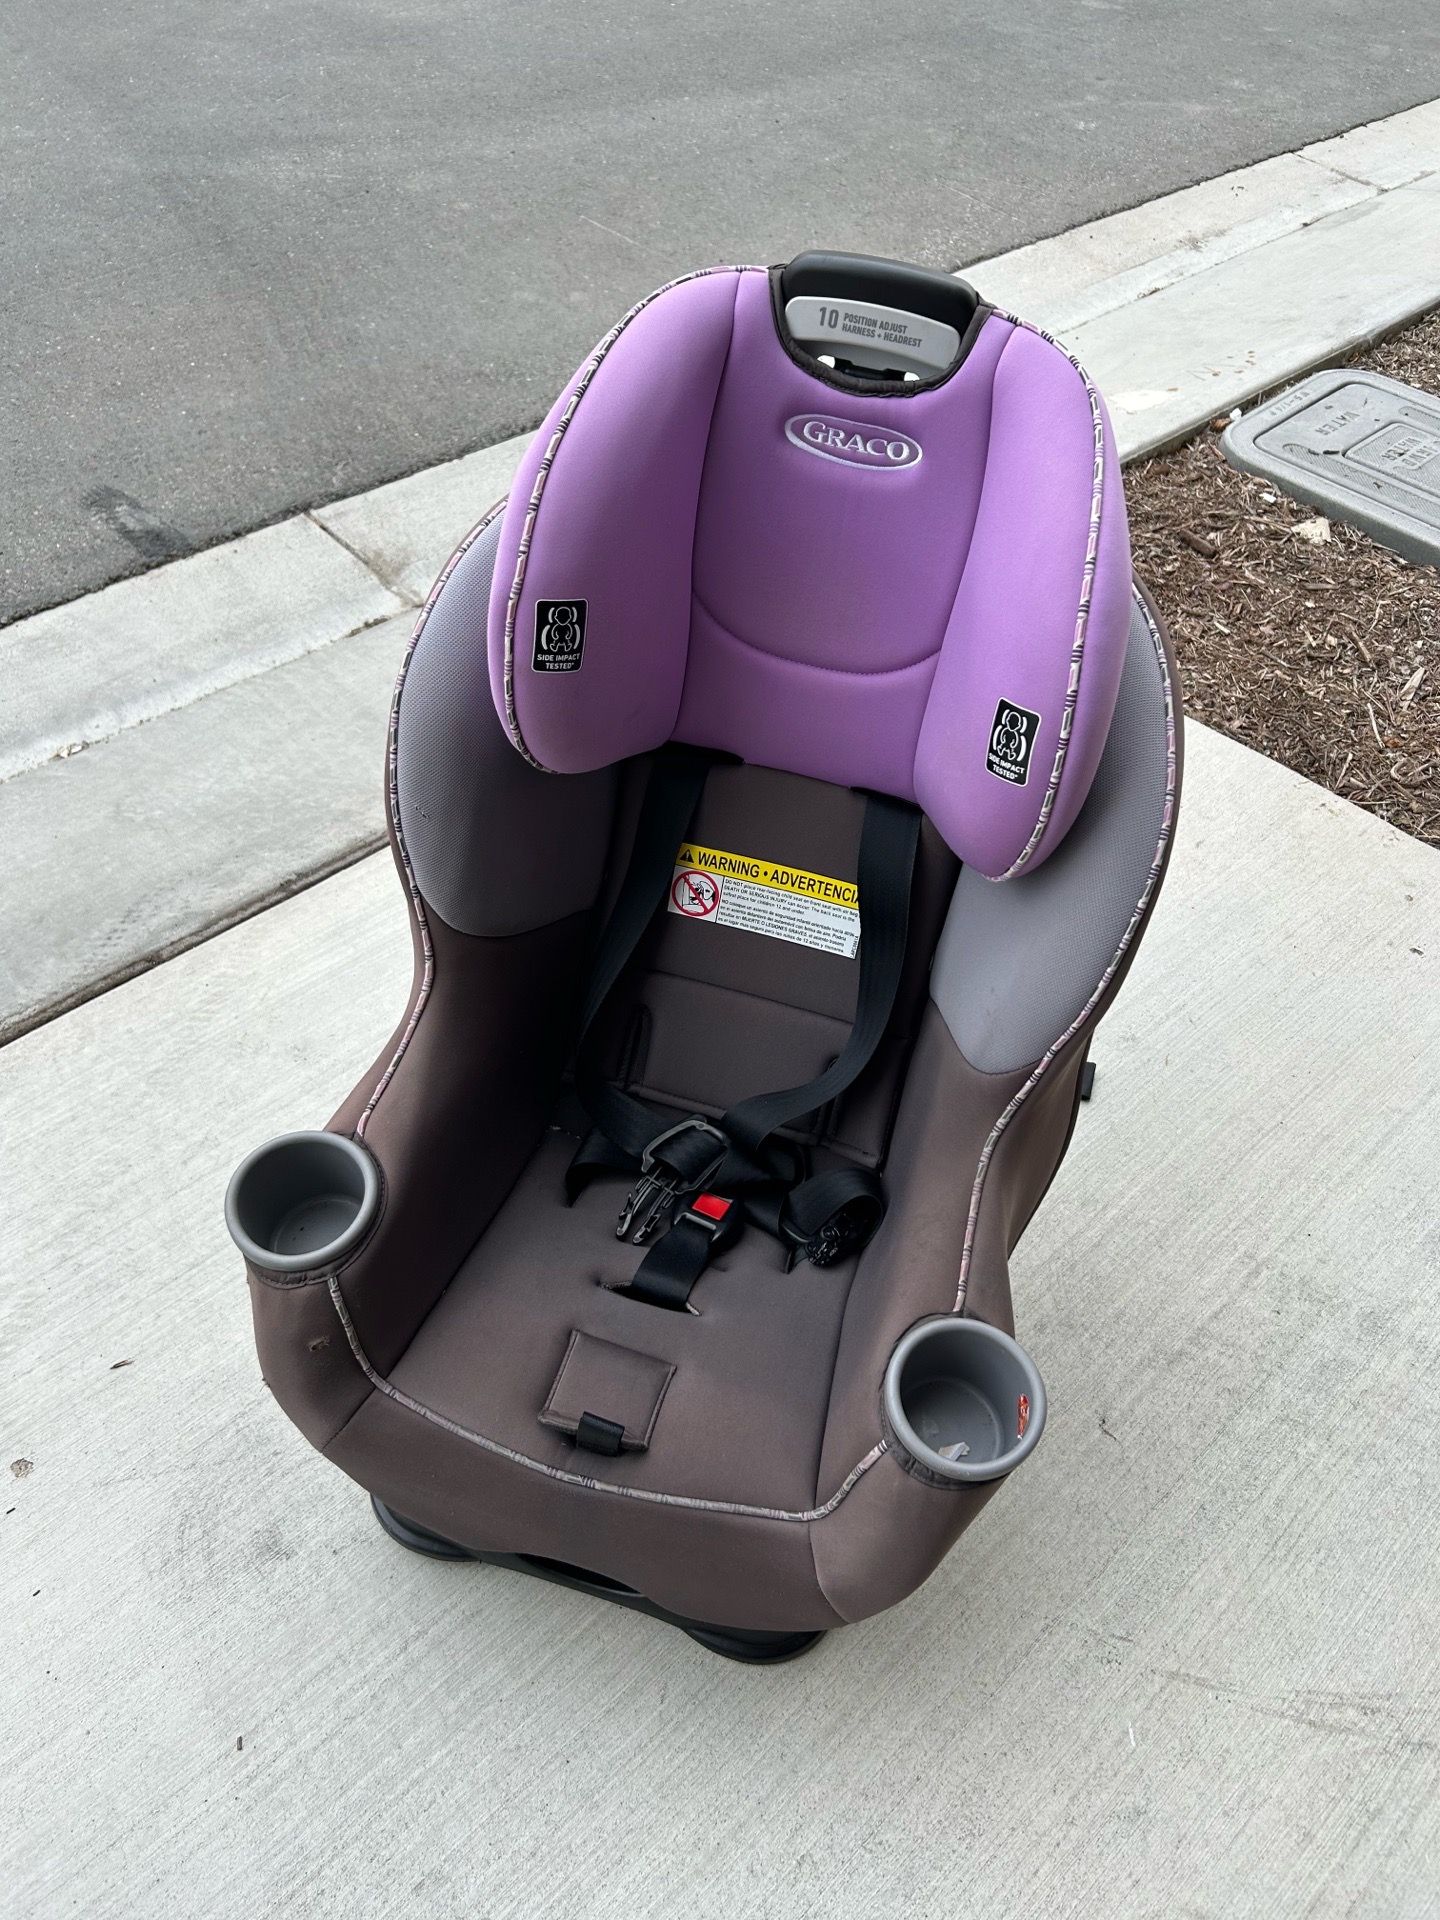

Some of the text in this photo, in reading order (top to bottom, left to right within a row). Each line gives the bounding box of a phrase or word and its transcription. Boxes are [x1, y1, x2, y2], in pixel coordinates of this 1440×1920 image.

[819, 306, 908, 333] 10 POSITION ADJUST
[842, 324, 876, 338] HARNESS
[884, 333, 922, 348] HEADREST
[803, 420, 910, 461] GRACO
[1381, 438, 1422, 460] WATER
[537, 653, 581, 662] SIDE IMPACT
[988, 752, 1025, 774] SIDE IMPACT
[698, 851, 760, 878] WARNING
[724, 884, 740, 892] DEATH
